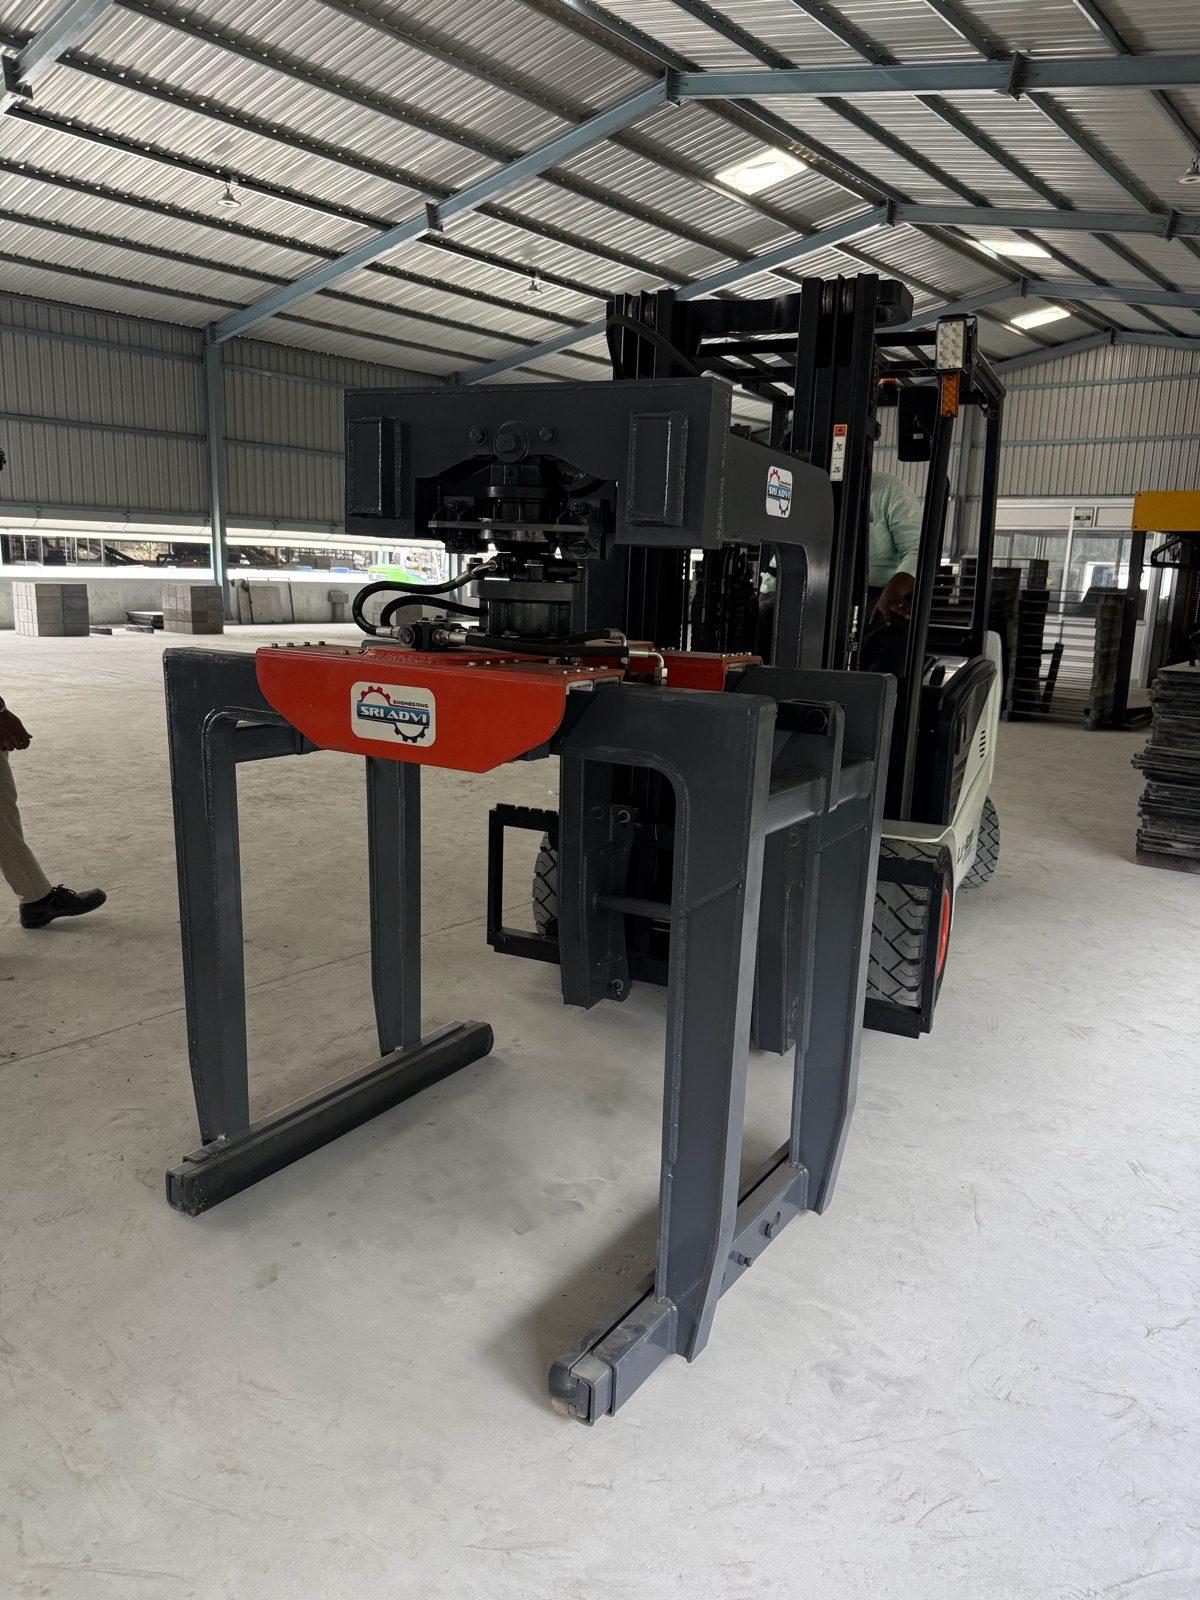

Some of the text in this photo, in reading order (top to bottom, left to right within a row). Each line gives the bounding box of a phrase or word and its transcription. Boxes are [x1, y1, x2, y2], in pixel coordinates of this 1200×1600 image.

[393, 700, 428, 708] ENGINEERING
[361, 706, 427, 723] SRI ADVI
